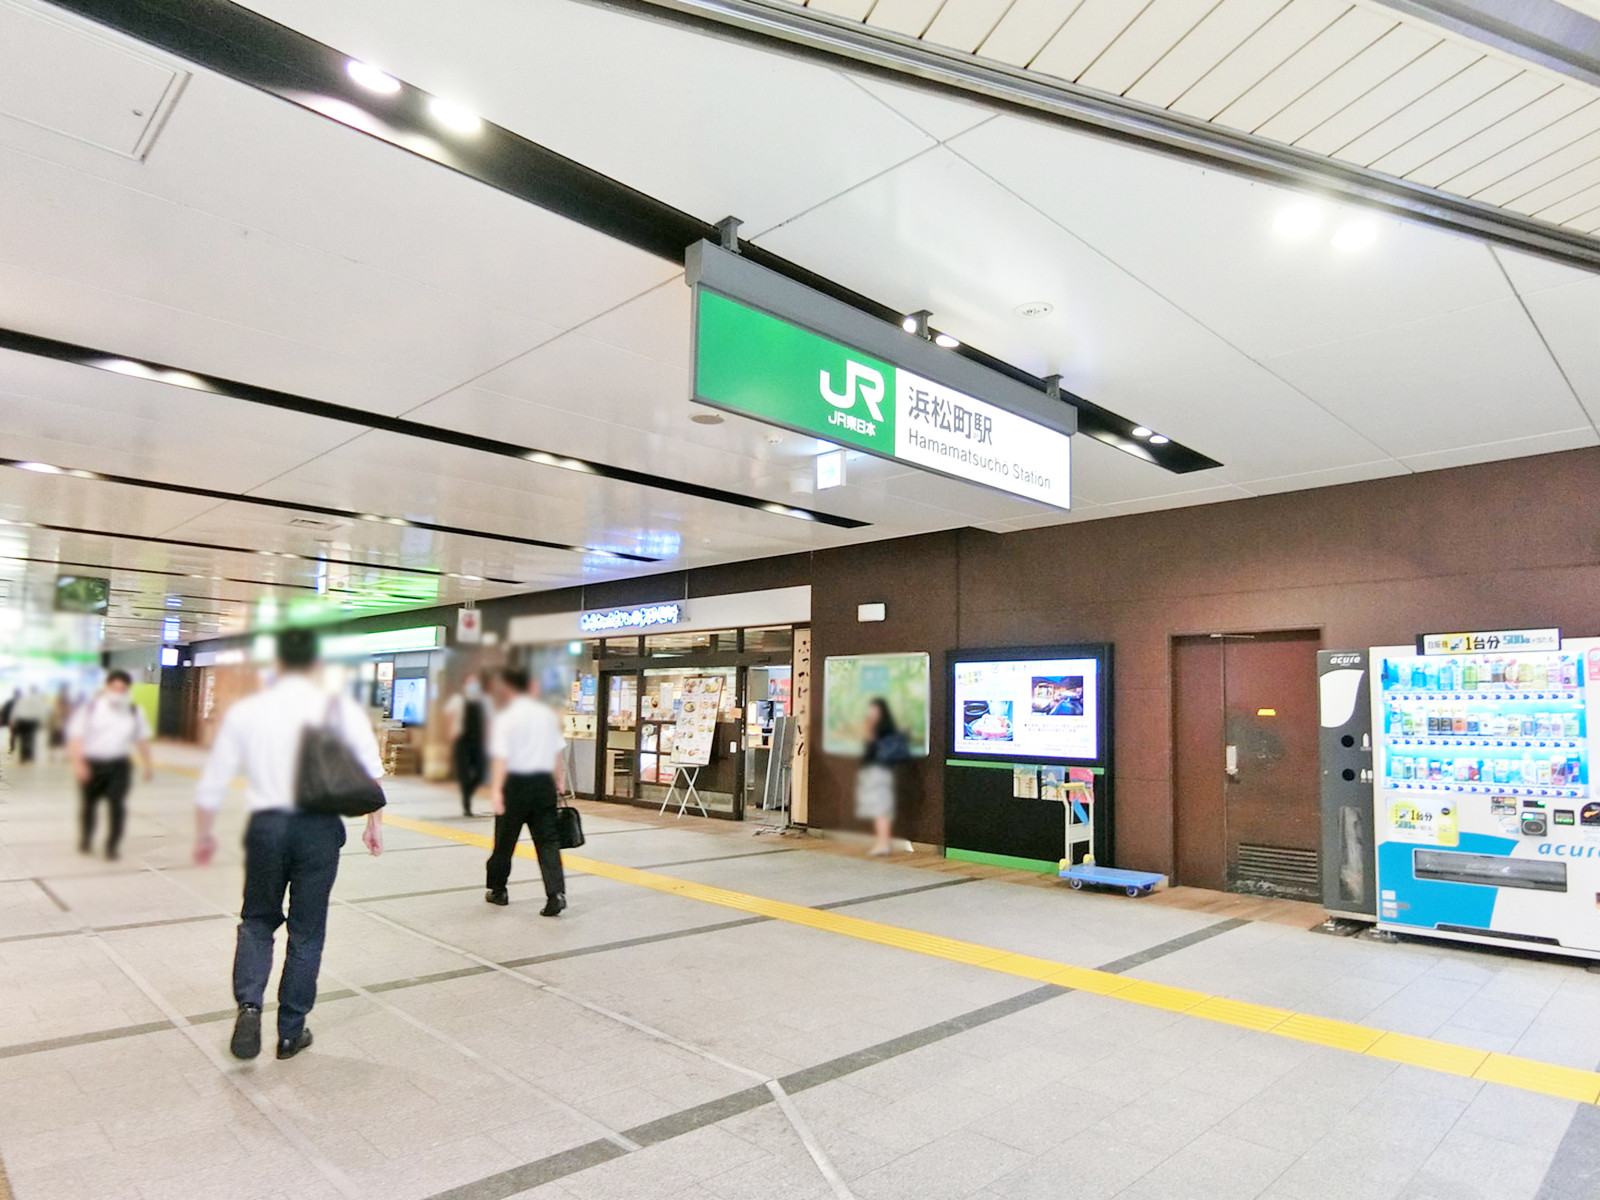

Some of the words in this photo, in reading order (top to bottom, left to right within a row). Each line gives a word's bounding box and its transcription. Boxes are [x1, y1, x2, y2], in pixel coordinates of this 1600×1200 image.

[820, 359, 884, 422] JR
[828, 411, 876, 437] JR東日本
[908, 386, 993, 446] 浜松町駅
[1013, 463, 1051, 489] Station
[1330, 656, 1361, 665] acure
